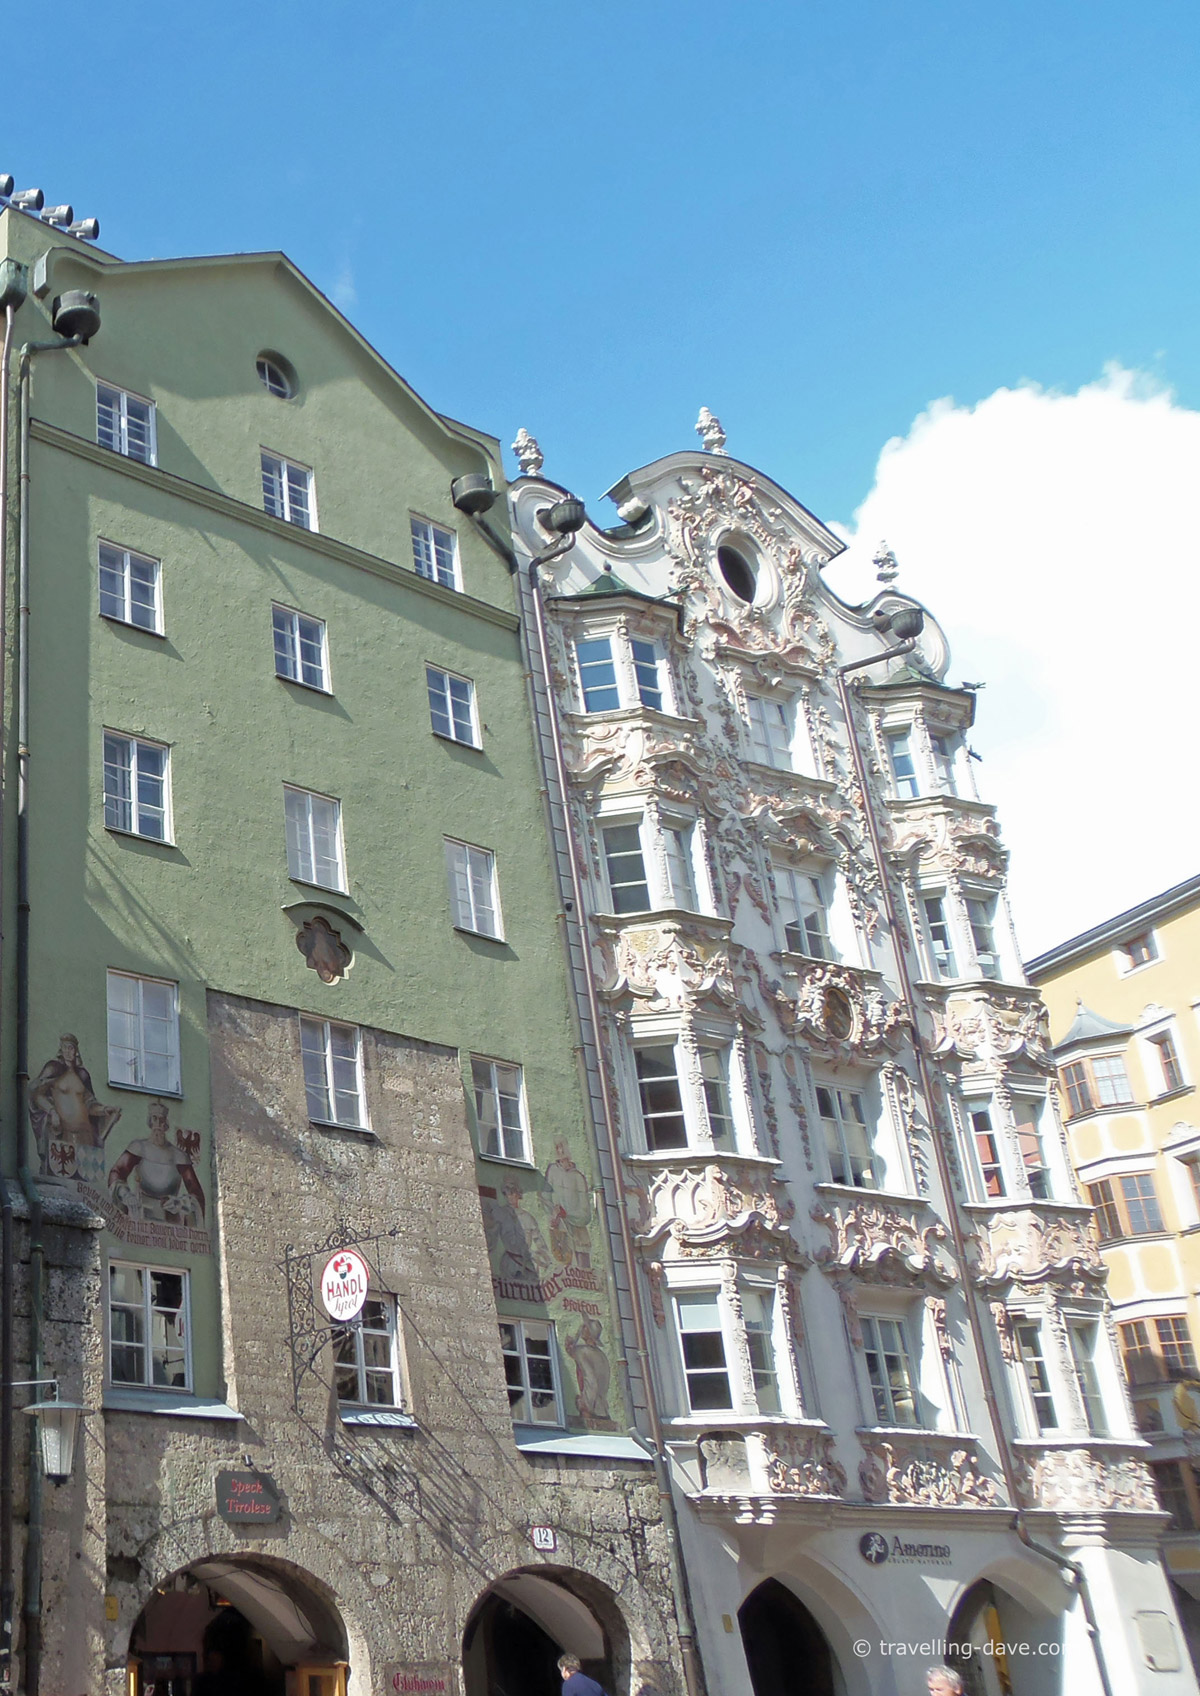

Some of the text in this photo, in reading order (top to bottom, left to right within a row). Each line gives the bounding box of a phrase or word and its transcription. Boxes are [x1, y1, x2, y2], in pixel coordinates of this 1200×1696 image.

[326, 1274, 364, 1301] HANDL
[231, 1478, 263, 1497] Speck
[225, 1498, 271, 1514] Tirolese
[537, 1528, 549, 1543] 12
